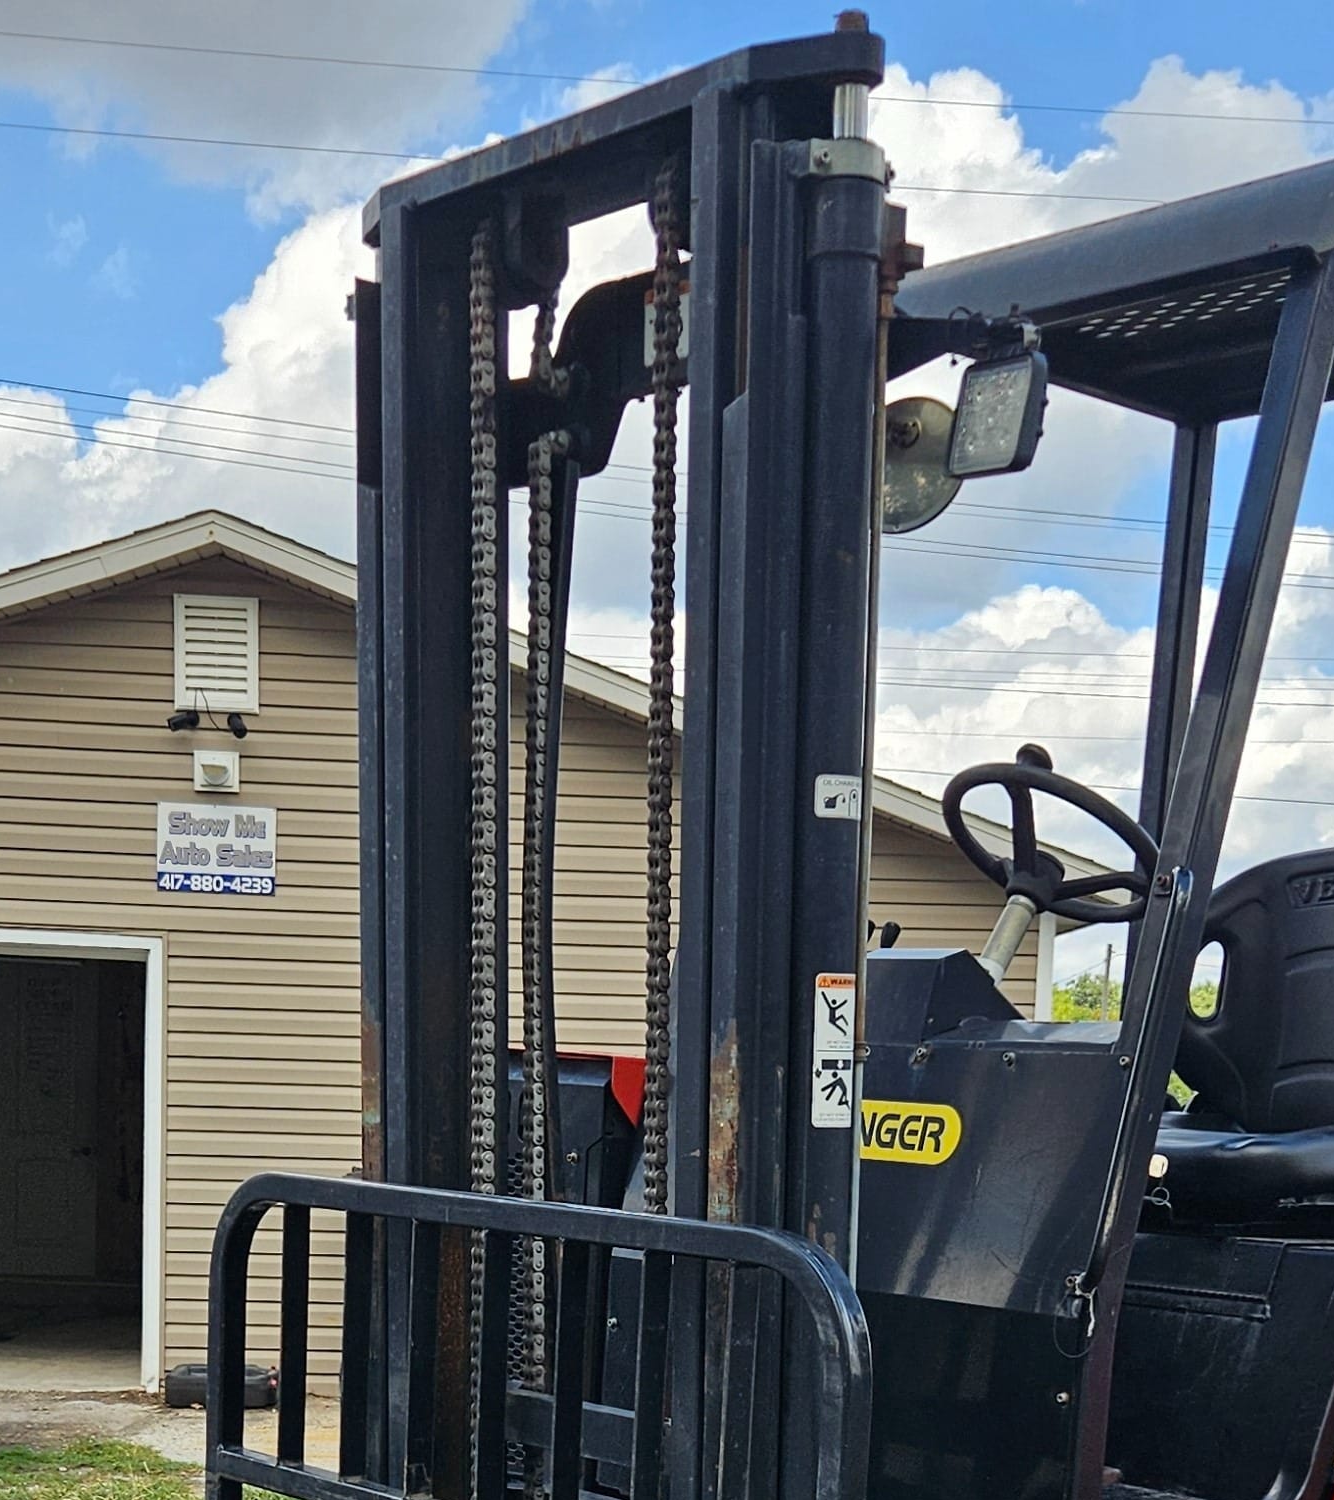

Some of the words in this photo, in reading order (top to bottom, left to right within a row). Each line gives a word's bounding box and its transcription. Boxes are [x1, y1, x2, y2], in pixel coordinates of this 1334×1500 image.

[168, 811, 230, 838] Show
[159, 841, 211, 867] Auto
[216, 844, 273, 869] Sales
[159, 874, 273, 894] 417-880-4239
